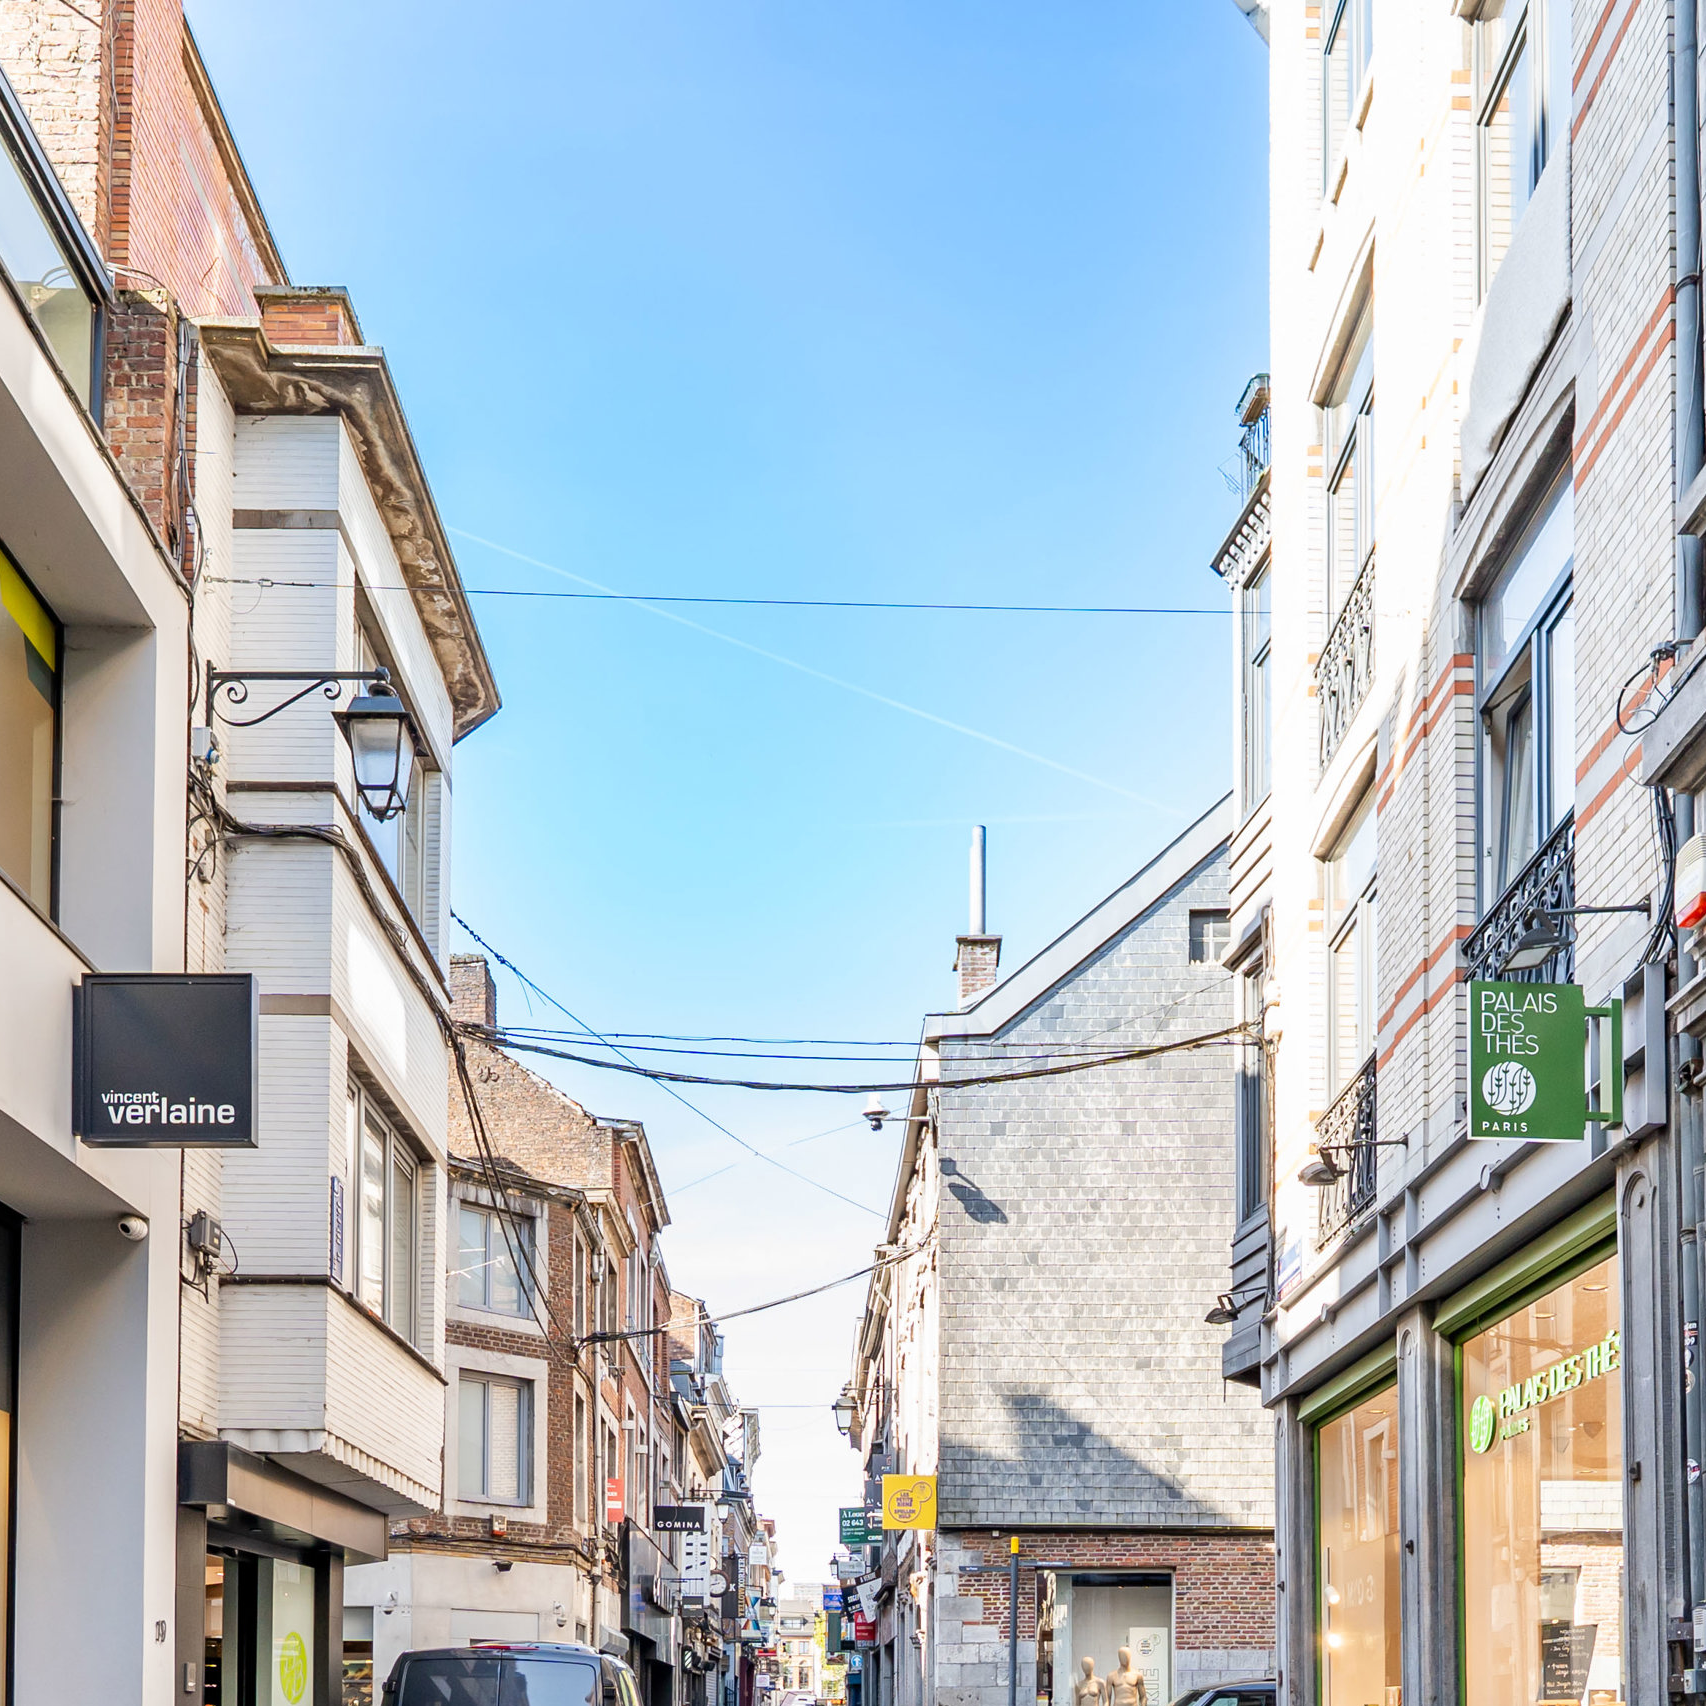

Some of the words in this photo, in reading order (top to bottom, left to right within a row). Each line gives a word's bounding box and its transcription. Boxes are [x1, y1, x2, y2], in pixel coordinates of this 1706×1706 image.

[1480, 990, 1558, 1014] PALAIS
[1480, 1012, 1525, 1034] DES
[100, 1089, 160, 1104] vincent
[107, 1096, 236, 1125] verlaine
[1481, 1121, 1529, 1133] PARIS
[1498, 1370, 1549, 1420] PALAIS
[1548, 1354, 1584, 1398] DES
[656, 1520, 701, 1529] GOMINA
[841, 1519, 851, 1527] 02
[850, 1519, 864, 1527] 643
